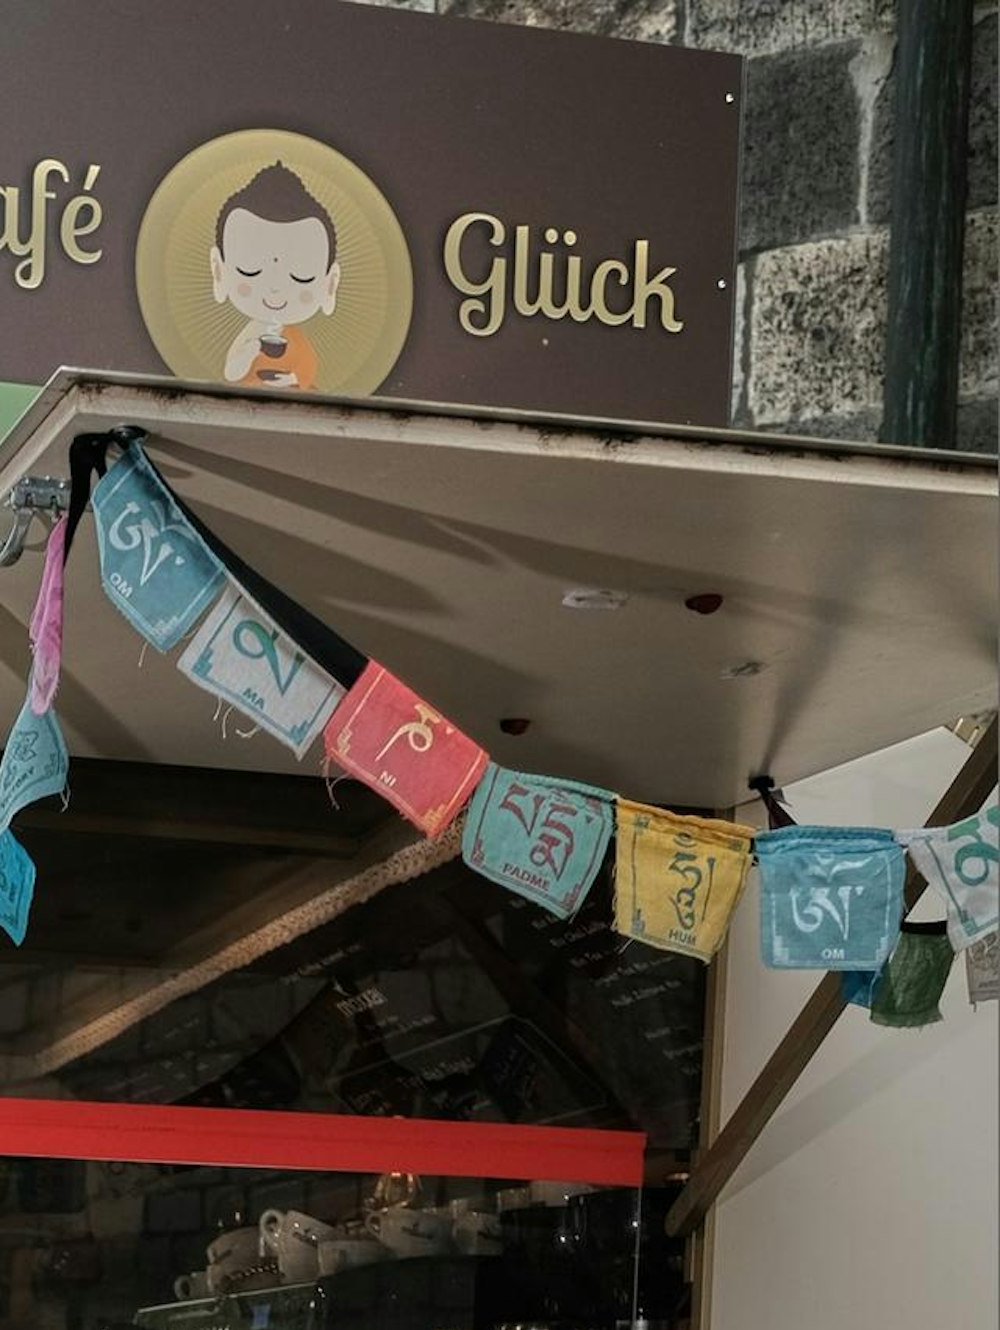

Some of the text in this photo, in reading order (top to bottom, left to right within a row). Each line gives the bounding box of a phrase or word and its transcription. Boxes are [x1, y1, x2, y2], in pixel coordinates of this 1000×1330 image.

[443, 212, 684, 337] Glück
[109, 572, 134, 599] OM
[242, 686, 267, 711] MA
[378, 770, 398, 788] NI
[501, 861, 552, 893] PADME
[667, 928, 698, 947] HUM
[820, 948, 845, 961] OM
